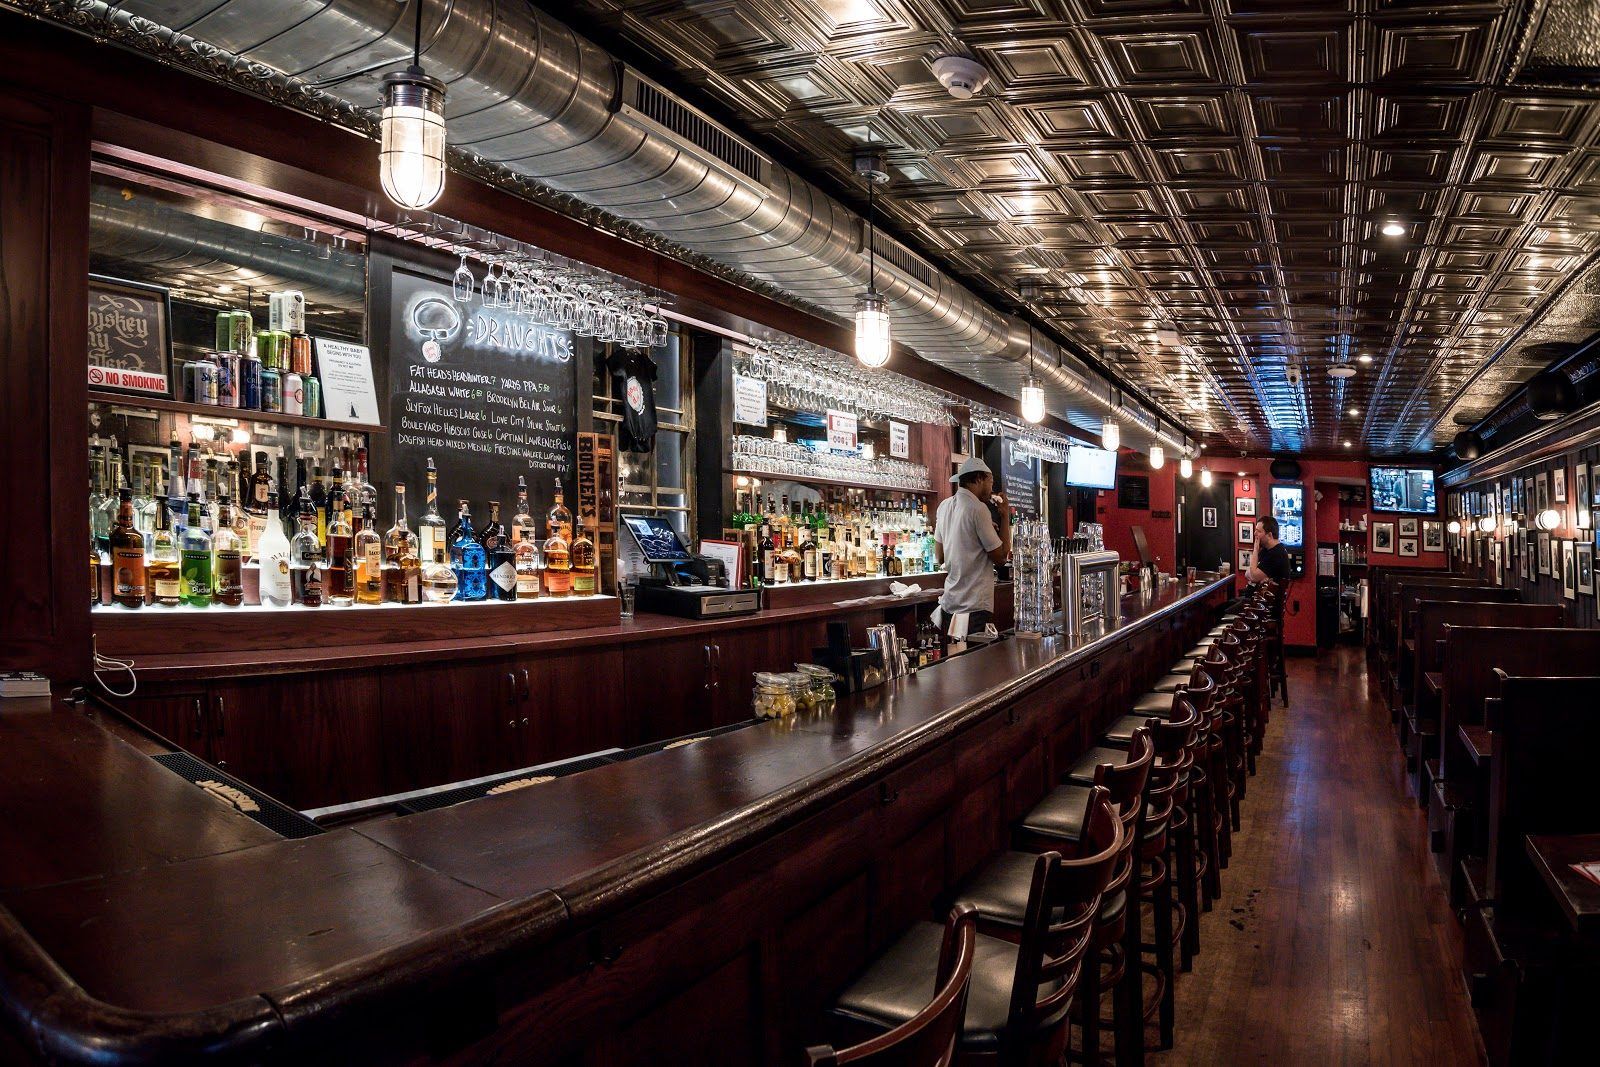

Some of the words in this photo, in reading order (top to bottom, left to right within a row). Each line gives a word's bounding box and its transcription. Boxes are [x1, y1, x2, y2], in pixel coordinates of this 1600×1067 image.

[328, 344, 349, 352] HEALTHY
[475, 315, 570, 362] DRAUGHTS
[105, 371, 119, 385] NO
[122, 373, 165, 391] SMOKING
[409, 365, 425, 378] FAT
[501, 377, 521, 391] YARDS
[523, 380, 538, 392] PPA
[409, 380, 446, 397] ALLAGASH
[447, 386, 471, 399] WHITE
[486, 390, 519, 409] BROOKLYN
[542, 400, 557, 413] SOUR
[401, 416, 443, 433] BOULEVARD
[443, 422, 470, 437] HIBISCUS
[433, 403, 458, 418] HELLES
[460, 408, 480, 421] LAGER
[491, 410, 508, 425] LOVE
[510, 414, 525, 428] CITY
[545, 419, 560, 432] STOUT
[398, 433, 426, 446] DOGFISH
[427, 437, 445, 447] HEAD
[445, 438, 466, 450] MIXED
